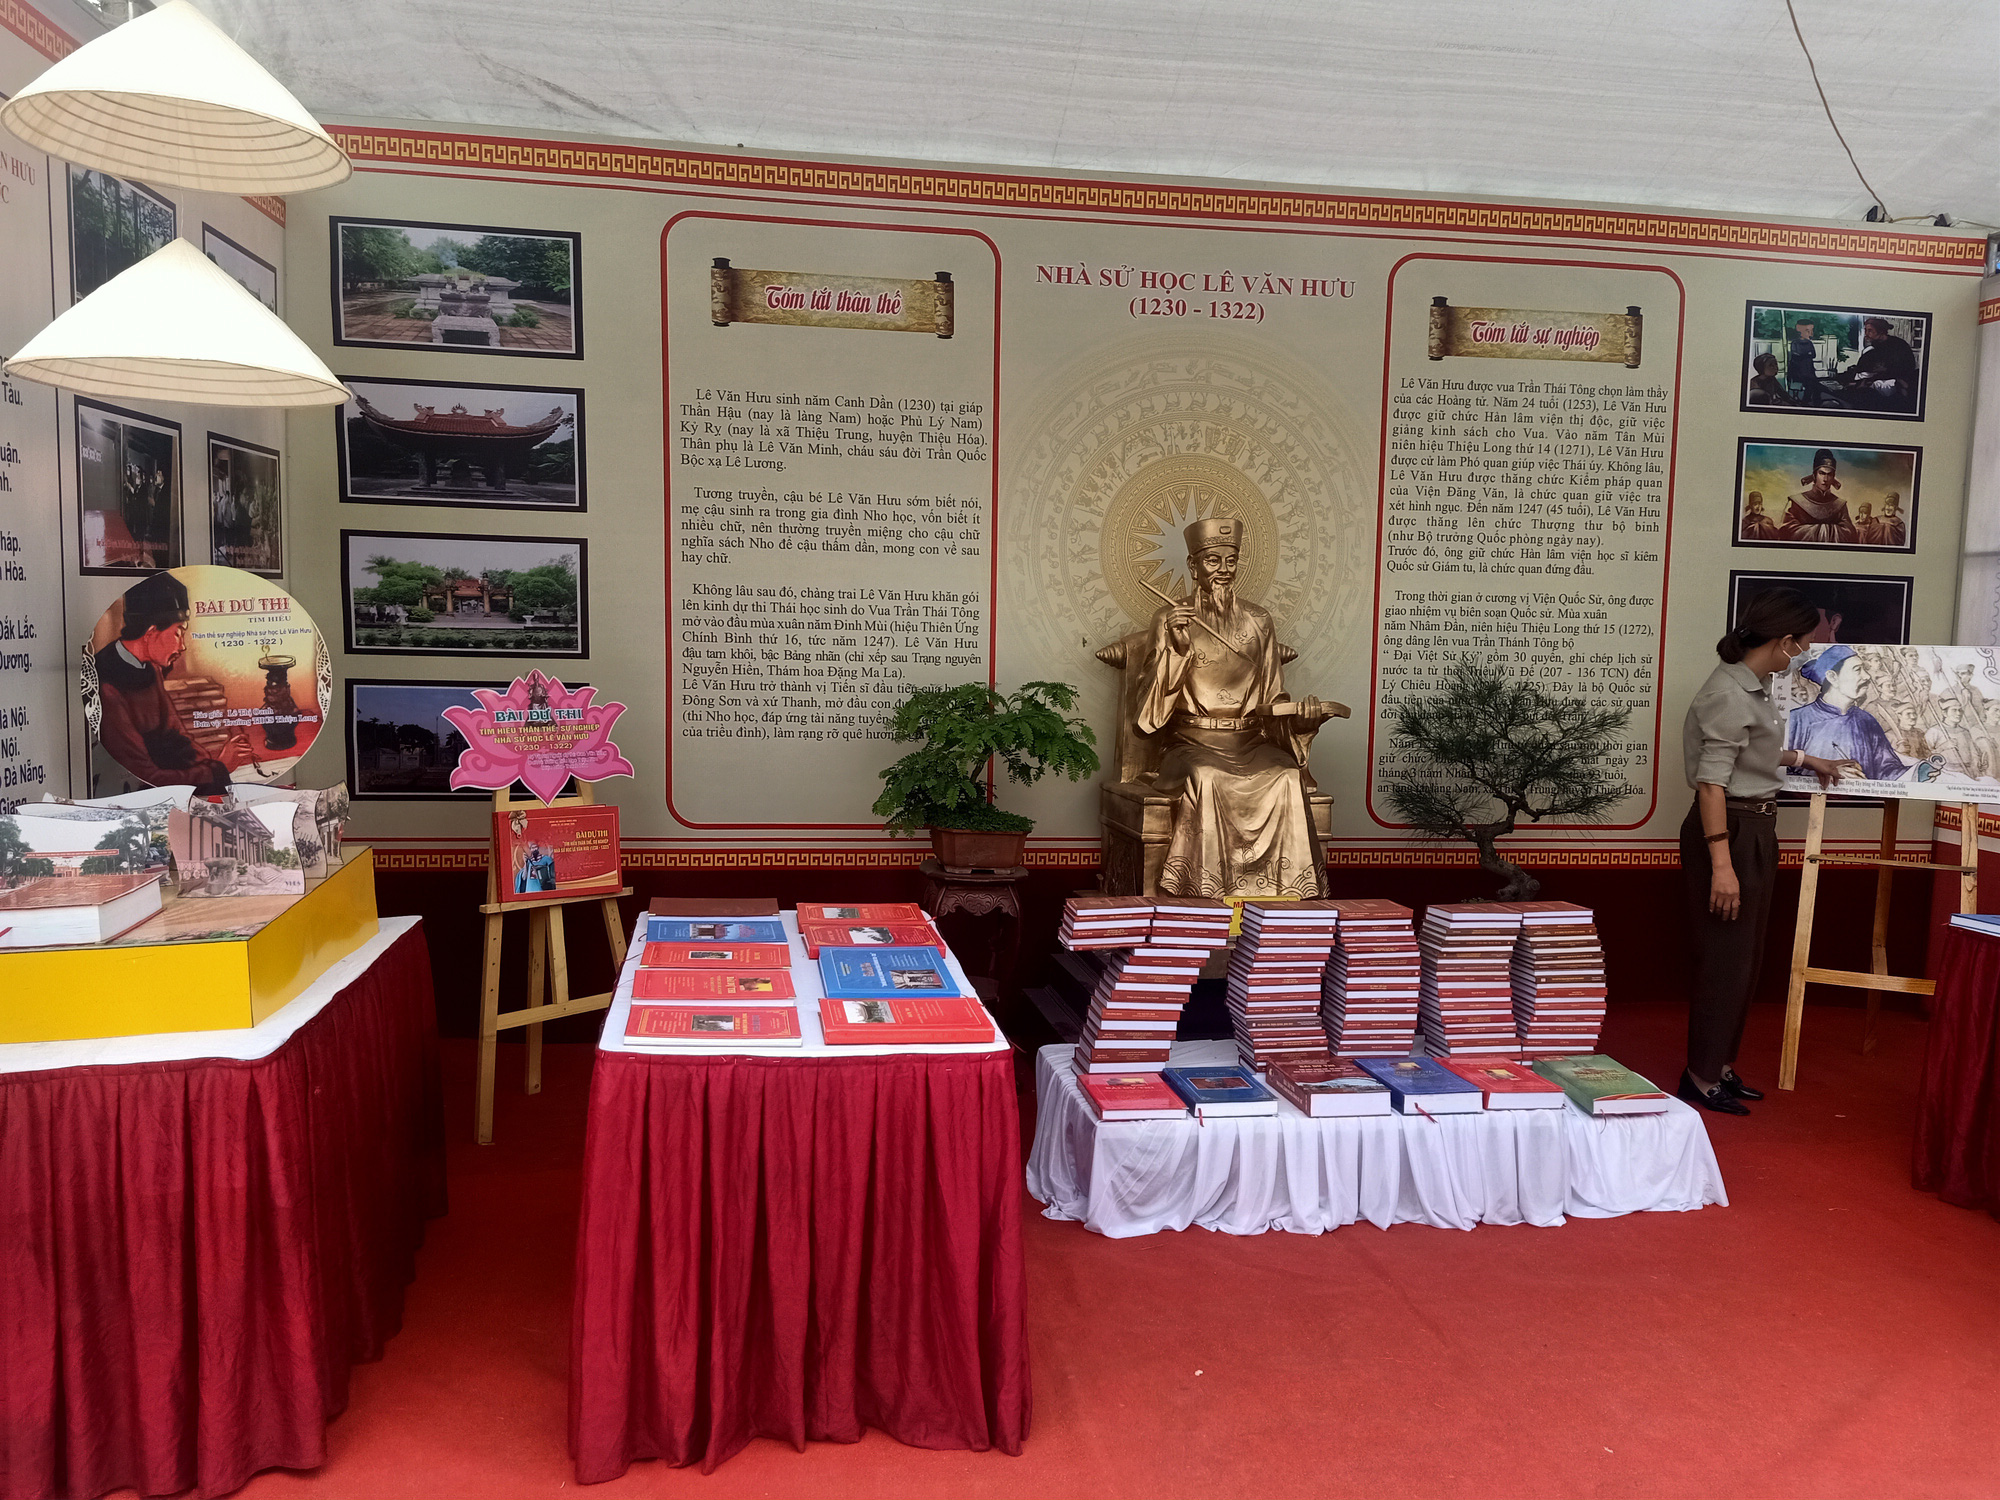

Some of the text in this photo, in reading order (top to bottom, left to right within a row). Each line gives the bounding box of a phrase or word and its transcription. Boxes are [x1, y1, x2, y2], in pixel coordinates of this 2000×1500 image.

[11, 156, 35, 186] HƯU
[1036, 262, 1356, 299] NHÀ SỬ HỌC LÊ VĂN HƯU
[765, 285, 902, 315] Tóm tắt thân thế
[1129, 297, 1187, 320] (1230
[1208, 301, 1266, 324] 1322)
[1471, 321, 1600, 352] Tóm tắt sự nghiệp
[2, 382, 23, 406] Tàu.
[1400, 377, 1668, 401] Lê Văn Hưu được vua Trần Thái Tông chọn làm thầy
[696, 388, 982, 416] Lê Văn Hưu sinh năm Canh Dần (1230) tại giáp
[1393, 392, 1667, 413] của các Hoàng tử. Năm 24 tuổi (1253), Lê Văn Hưu
[679, 402, 982, 432] Thần Hậu (nay là làng Nam) hoặc Phủ Lý Nam)
[680, 420, 987, 448] Kỷ Rỵ (nay là xã Thiệu Trung, huyện Thiệu Hóa).
[0, 530, 21, 556] háp.
[4, 560, 26, 581] Hòa.
[258, 597, 290, 611] THI
[18, 614, 37, 639] Lắc.
[226, 630, 246, 640] nghiệp
[268, 629, 278, 637] học
[220, 640, 244, 648] 1230
[254, 638, 277, 646] 1322
[10, 706, 29, 731] Nội.
[494, 708, 524, 722] BÀI
[556, 709, 582, 720] THI
[2, 737, 20, 762] Nội.
[4, 759, 46, 788] Đà Nẵng.
